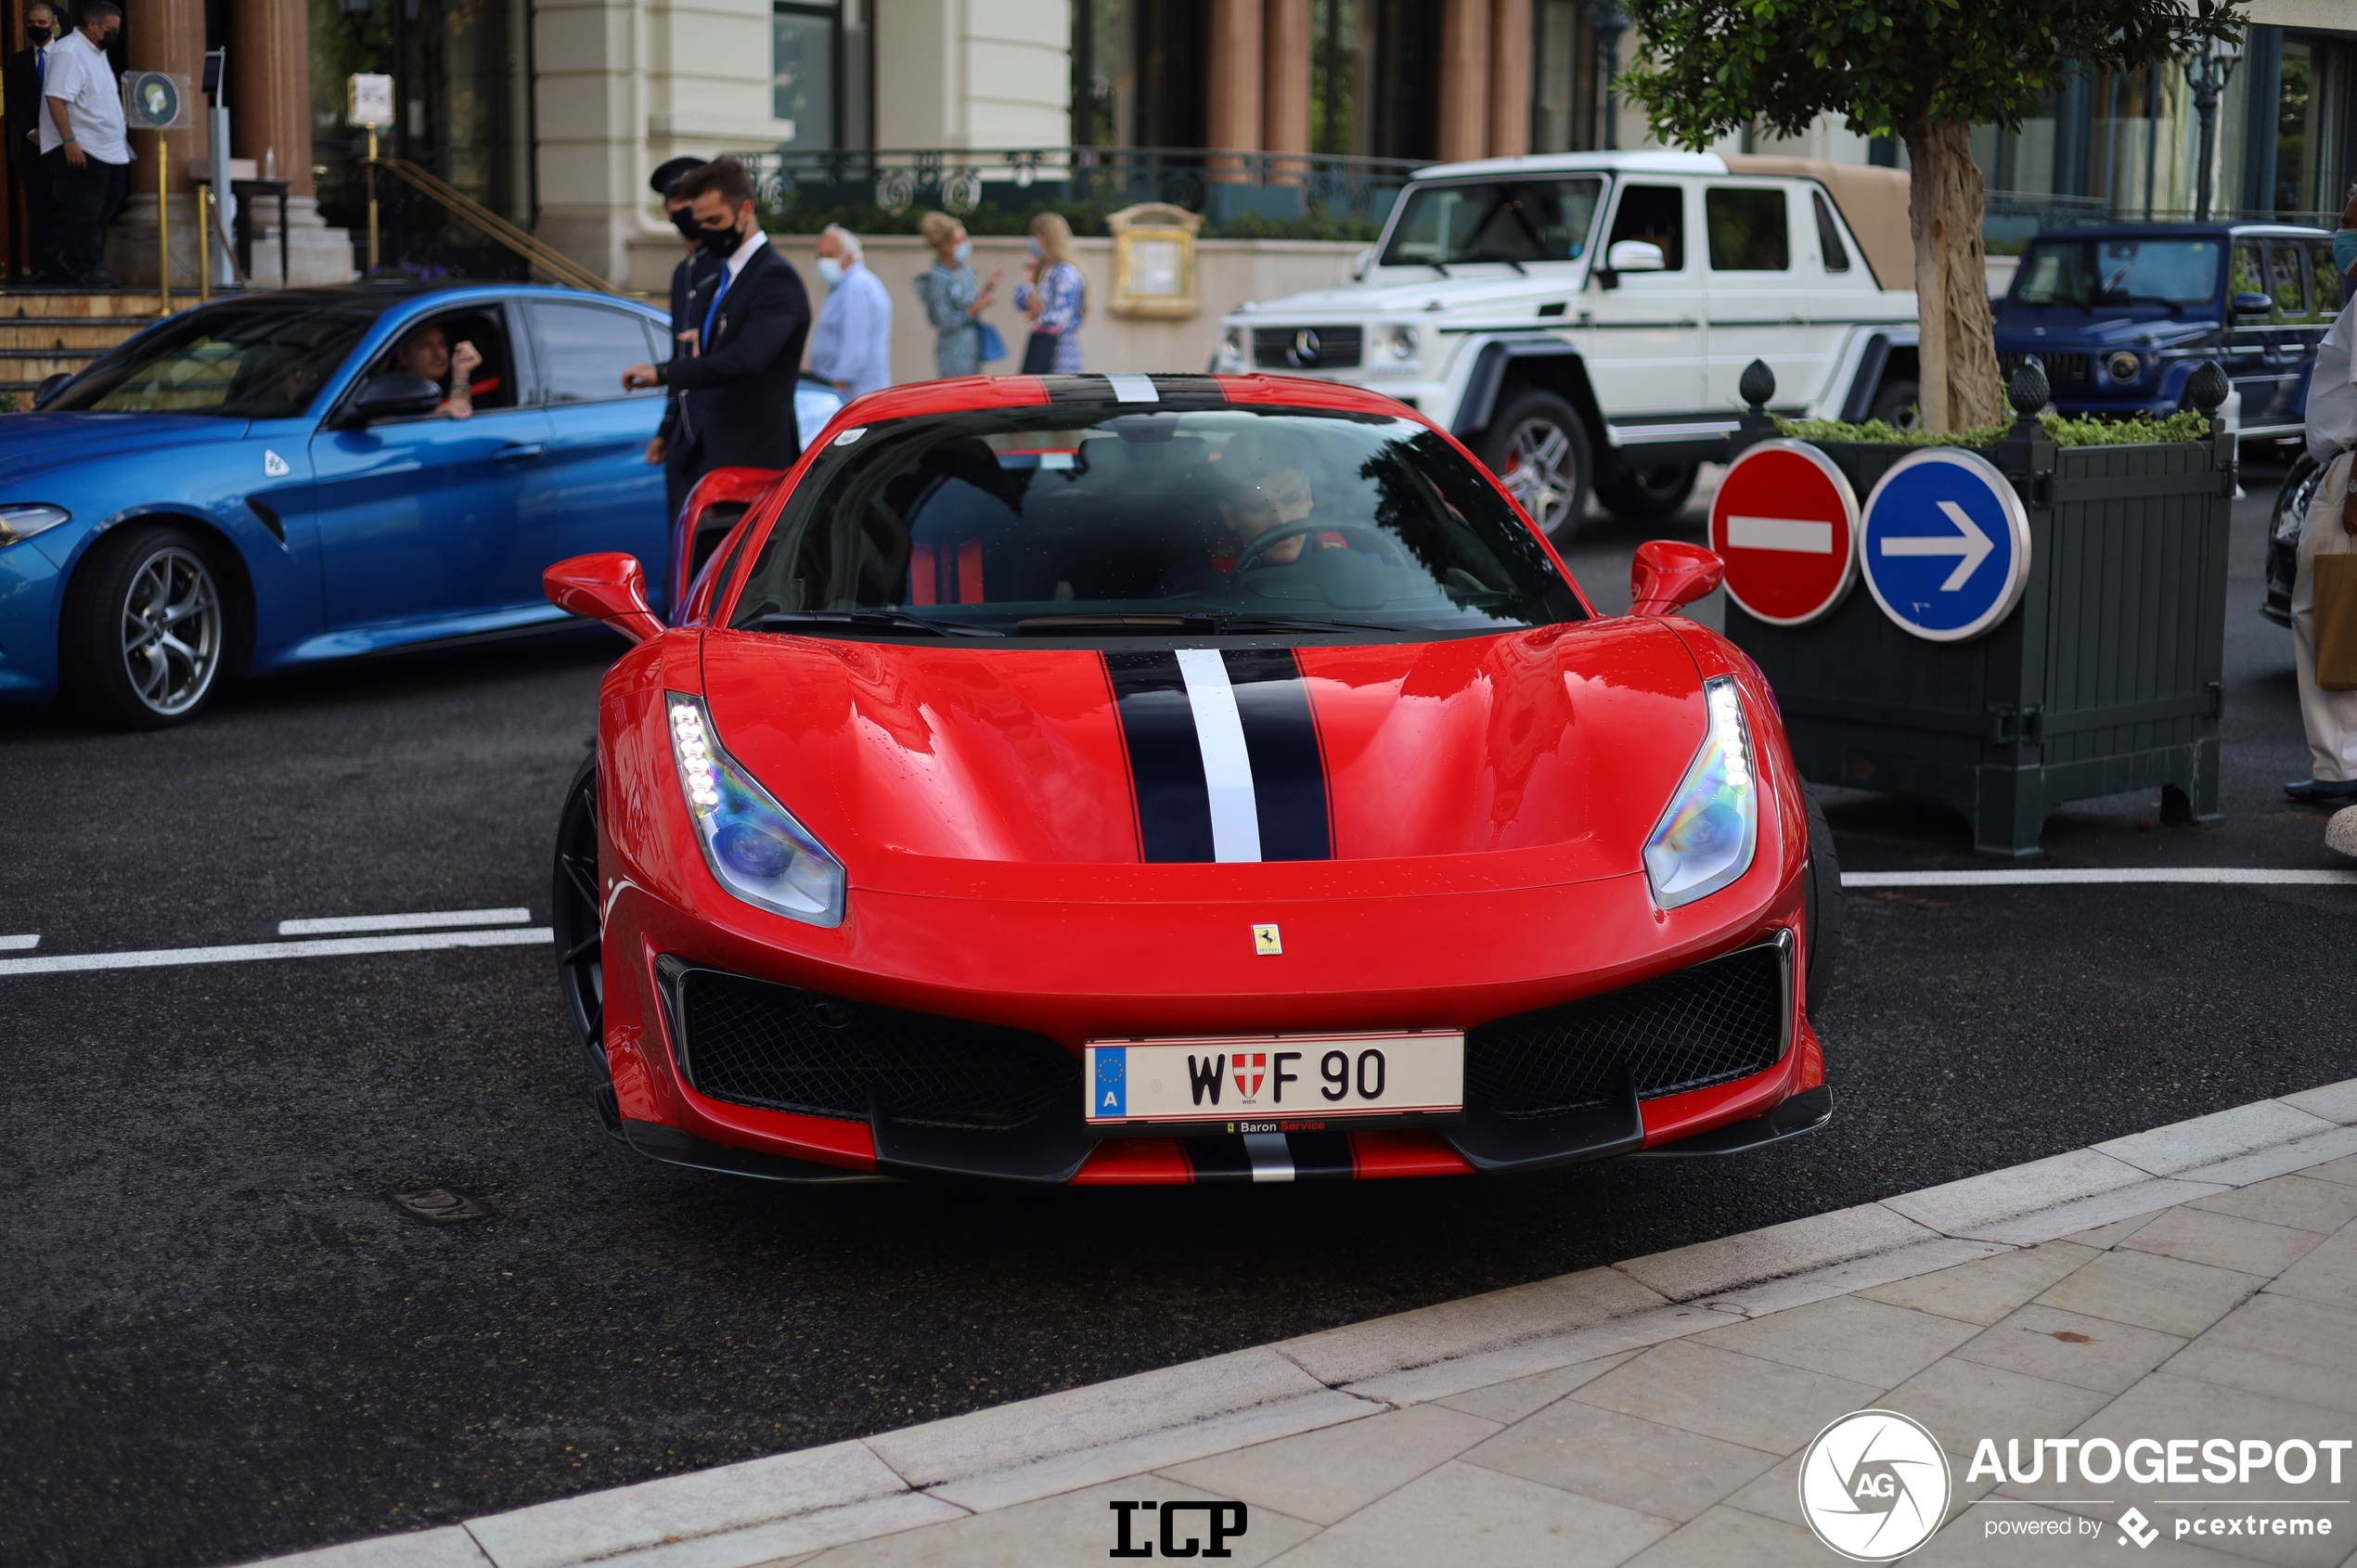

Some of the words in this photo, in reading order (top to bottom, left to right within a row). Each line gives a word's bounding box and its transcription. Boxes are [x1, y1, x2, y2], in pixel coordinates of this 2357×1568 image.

[1103, 1091, 1118, 1107] A
[1241, 1122, 1277, 1133] Baron
[1281, 1121, 1325, 1131] Service
